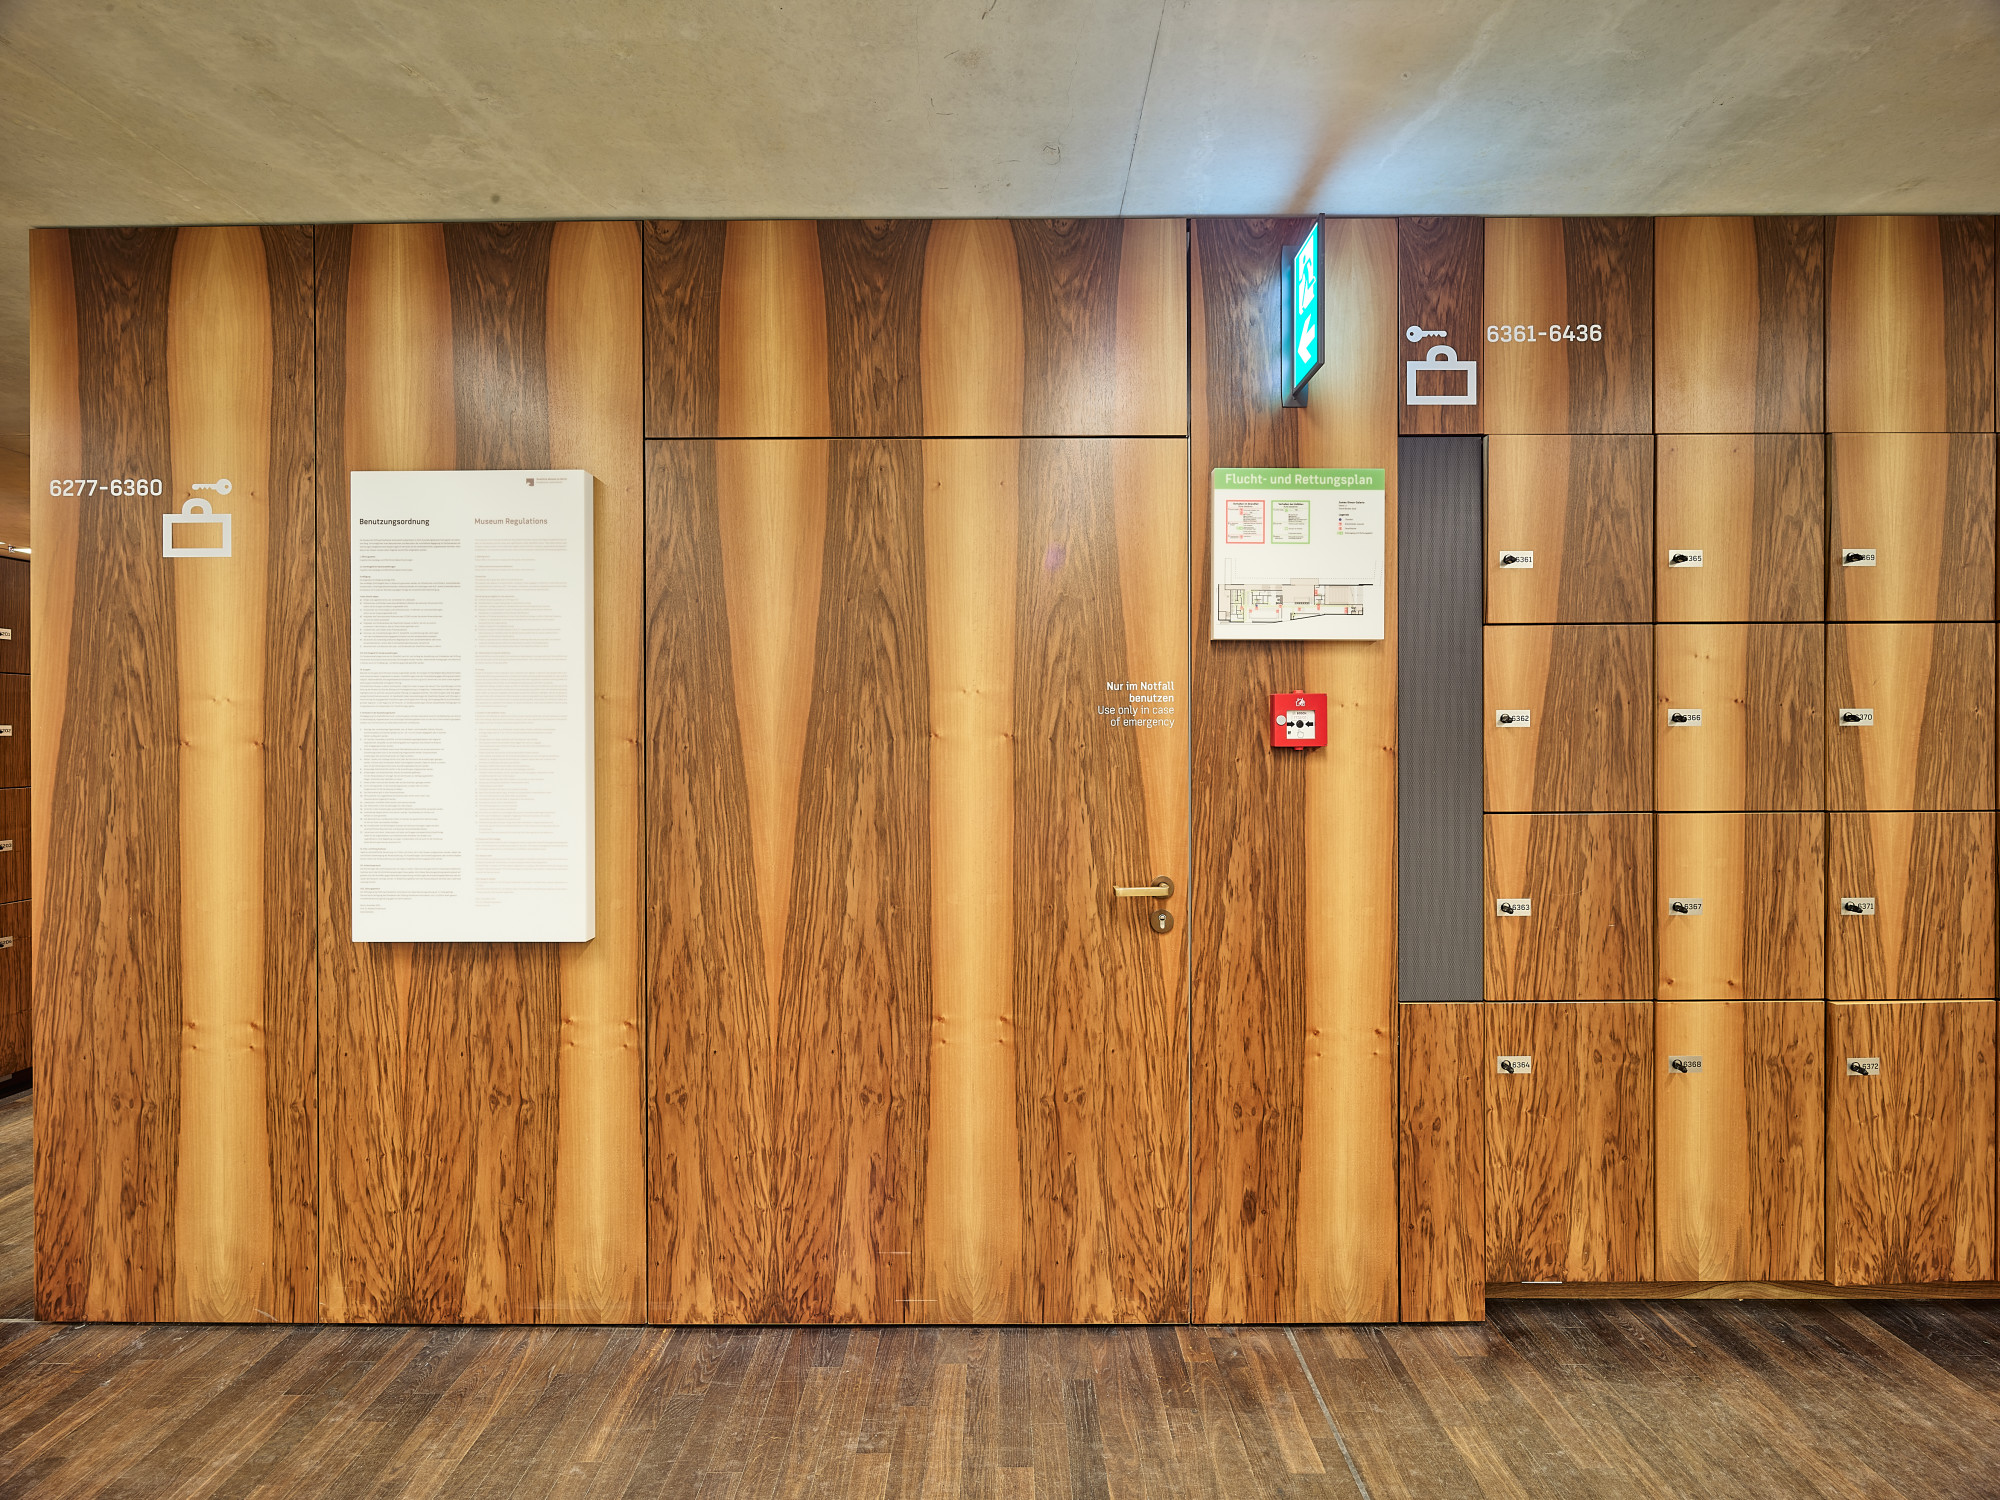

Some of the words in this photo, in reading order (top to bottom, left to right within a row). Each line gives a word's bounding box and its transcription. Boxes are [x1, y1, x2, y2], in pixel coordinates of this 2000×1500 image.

[1487, 324, 1602, 343] 6361-6436
[1225, 473, 1267, 485] Flucht-
[1270, 474, 1292, 485] und
[1295, 474, 1373, 488] Rettungsplan
[49, 478, 163, 497] 6277-6360
[359, 518, 430, 527] Benutzungsordnung
[505, 517, 548, 526] Regulations
[1106, 681, 1124, 691] Nur
[1126, 681, 1138, 691] im
[1140, 681, 1175, 691] Notfall
[1129, 693, 1174, 703] benutzen
[1097, 705, 1116, 715] Use
[1118, 704, 1138, 716] only
[1140, 705, 1150, 714] in
[1152, 706, 1175, 714] case
[1110, 717, 1121, 727] of
[1122, 718, 1175, 729] emergency
